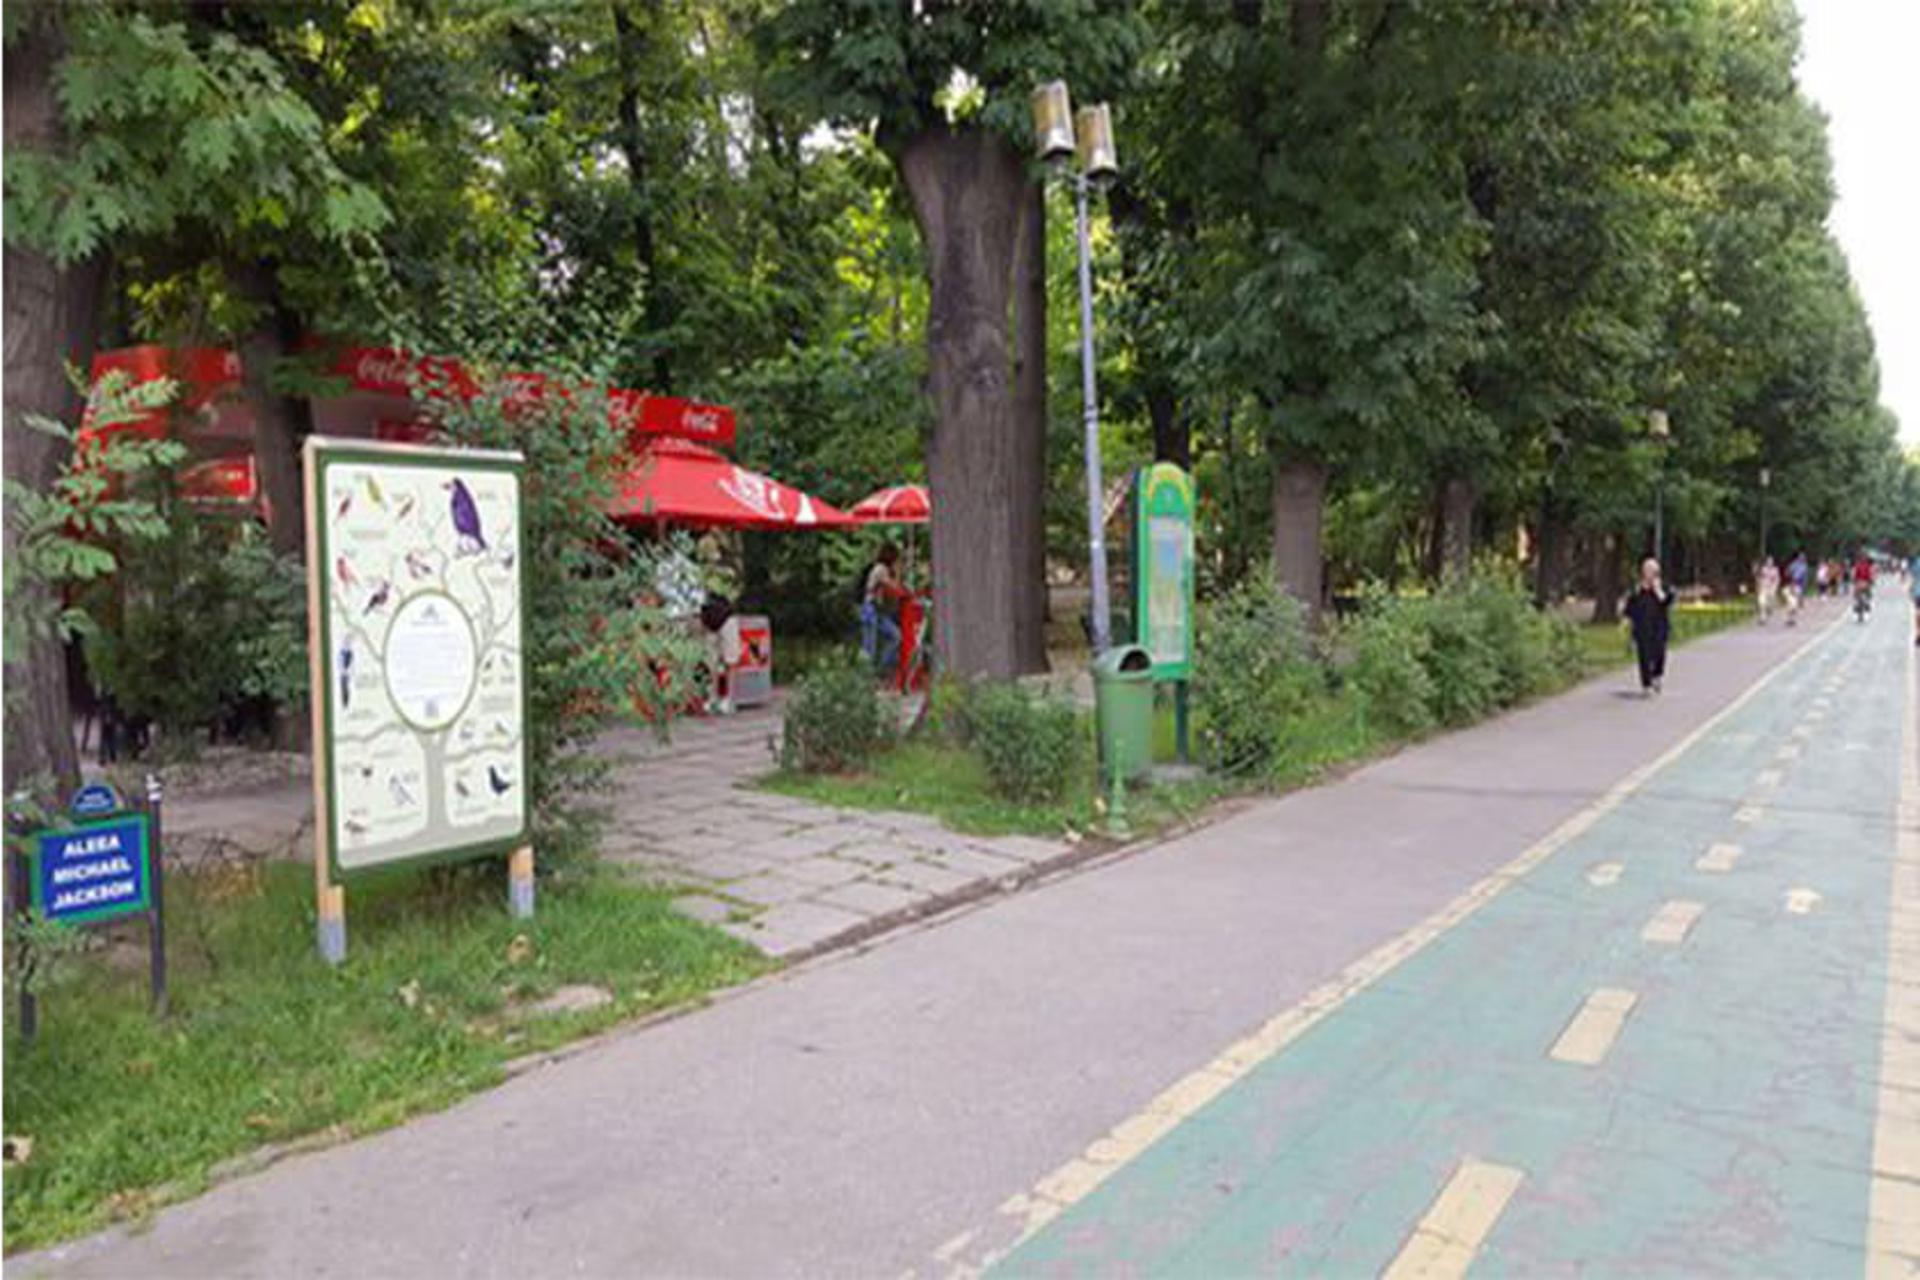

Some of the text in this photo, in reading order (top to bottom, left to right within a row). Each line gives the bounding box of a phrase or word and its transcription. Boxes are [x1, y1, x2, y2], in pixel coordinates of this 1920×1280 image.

[63, 835, 120, 859] ALEEA
[53, 857, 132, 885] MICHAEL
[54, 880, 135, 909] JACKSON
